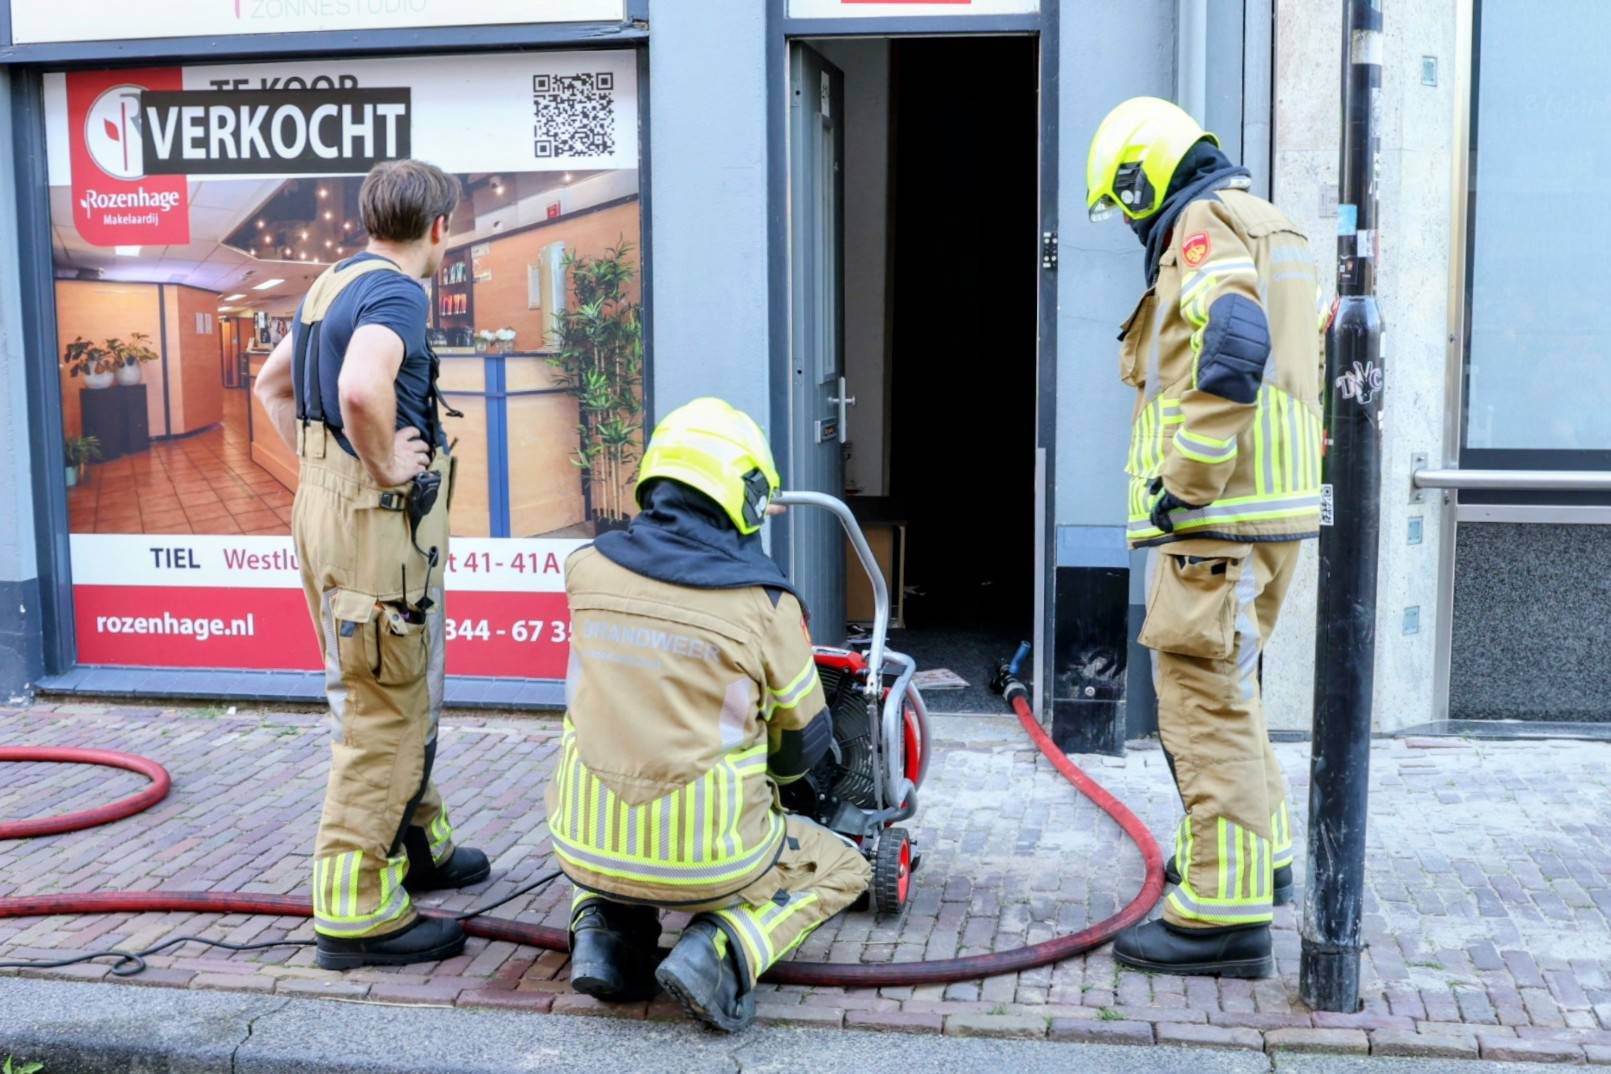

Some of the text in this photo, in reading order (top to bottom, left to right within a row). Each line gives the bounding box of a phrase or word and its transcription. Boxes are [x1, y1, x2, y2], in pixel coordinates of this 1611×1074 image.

[146, 103, 406, 160] VERKOCHT
[81, 187, 180, 218] Rozenhage
[103, 212, 159, 227] Makelaardij
[150, 548, 201, 569] TIEL
[223, 548, 299, 570] Westlu
[96, 611, 255, 641] rozenhage.nl
[511, 620, 544, 642] 67
